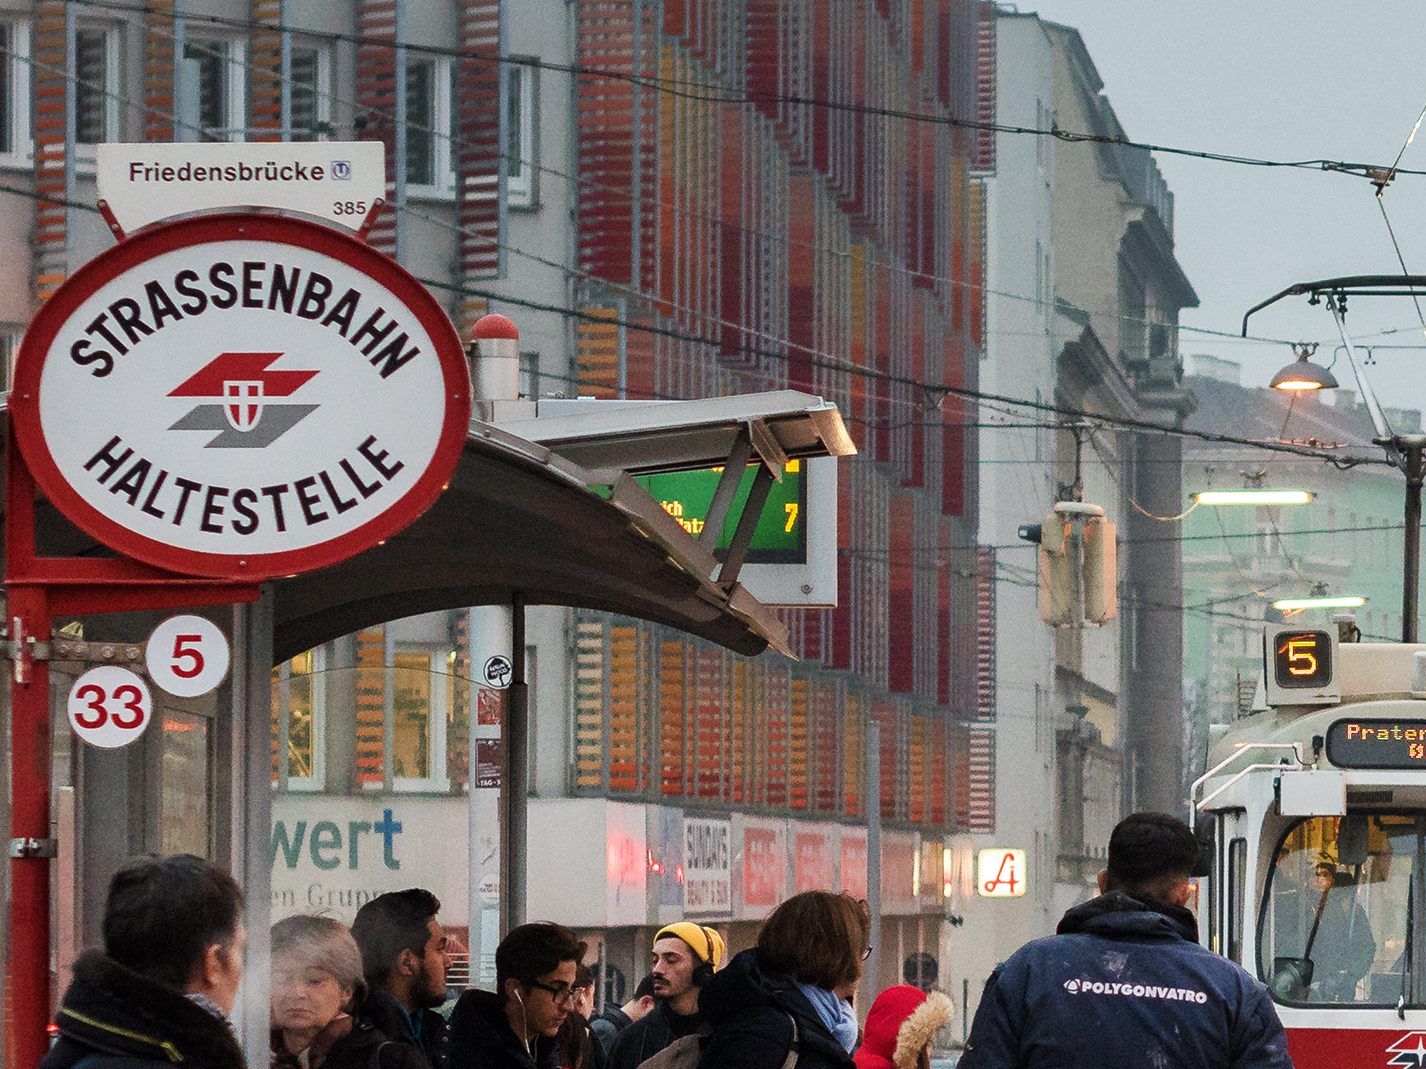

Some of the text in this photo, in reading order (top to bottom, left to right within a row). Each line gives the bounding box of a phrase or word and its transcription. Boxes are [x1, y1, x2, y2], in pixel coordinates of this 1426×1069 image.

[129, 161, 325, 183] Friedensbrücke
[332, 201, 366, 216] 385
[71, 261, 420, 380] STRASSENBAHN
[84, 434, 405, 536] HALTESTELLE
[784, 503, 799, 533] 7
[170, 635, 205, 679] 5
[1288, 641, 1317, 675] 5
[74, 684, 145, 730] 33
[1081, 980, 1208, 1004] POLYGONVATRO
